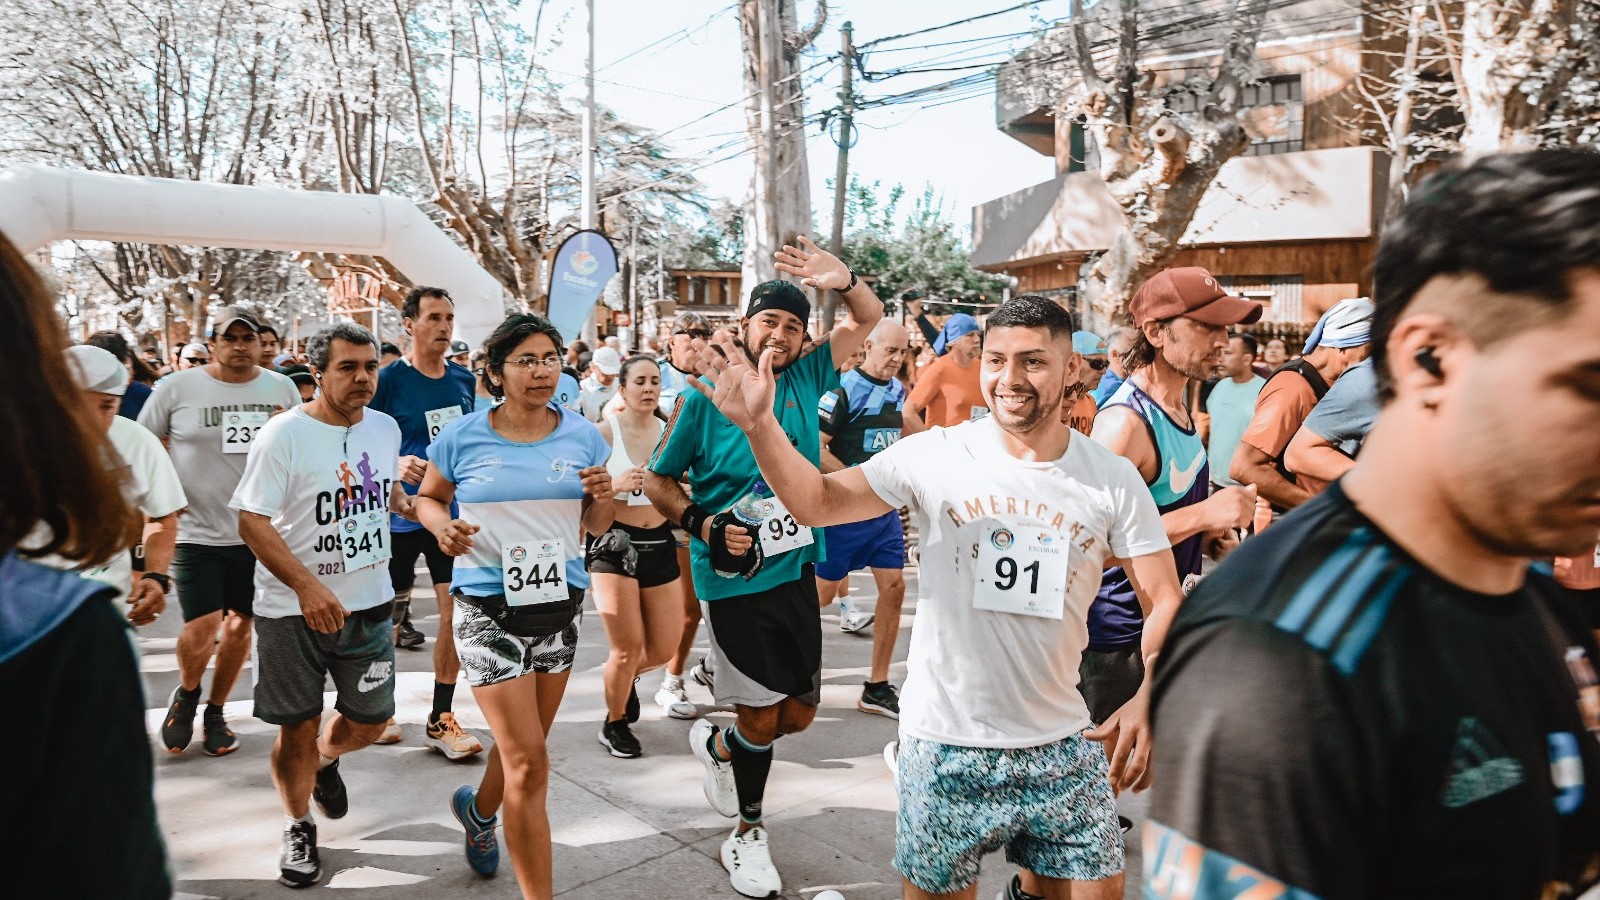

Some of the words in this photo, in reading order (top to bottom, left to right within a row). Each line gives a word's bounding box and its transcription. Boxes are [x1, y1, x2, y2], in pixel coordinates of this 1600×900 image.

[768, 513, 799, 541] 93
[946, 494, 1096, 554] AMERICANA
[344, 528, 384, 559] 341
[507, 562, 563, 592] 344
[994, 556, 1040, 594] 91
